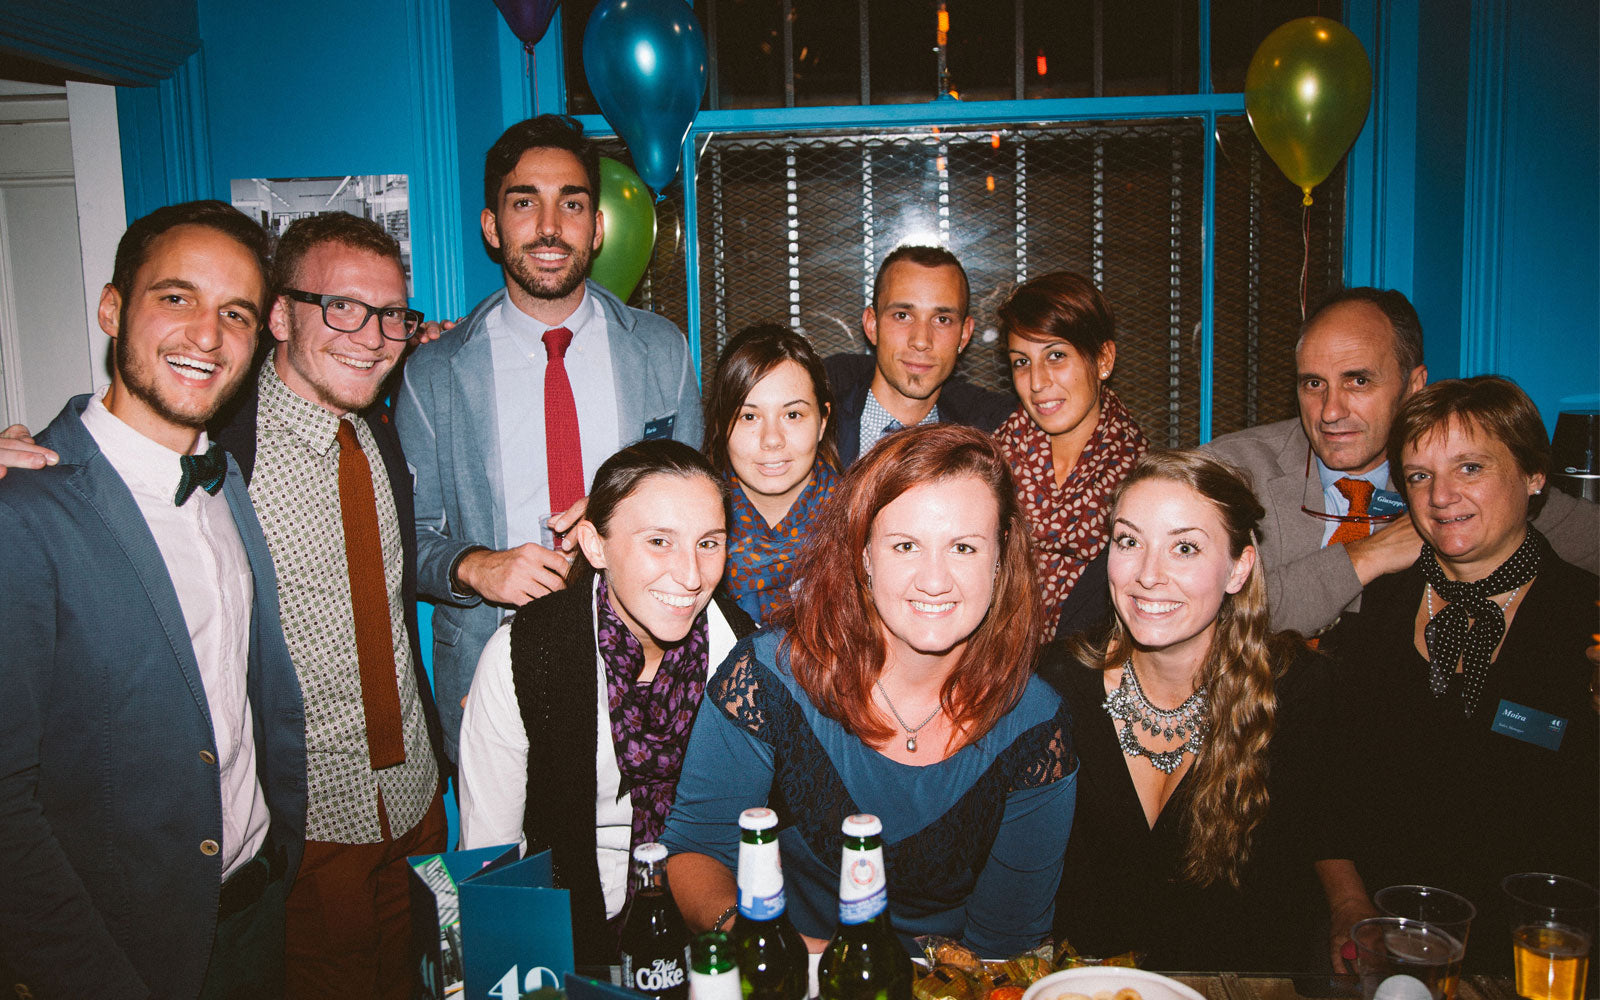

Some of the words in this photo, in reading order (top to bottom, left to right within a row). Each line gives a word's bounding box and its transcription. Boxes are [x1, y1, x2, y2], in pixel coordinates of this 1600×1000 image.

[1502, 708, 1527, 722] Moira
[651, 958, 678, 973] Diet
[636, 964, 685, 991] Coke
